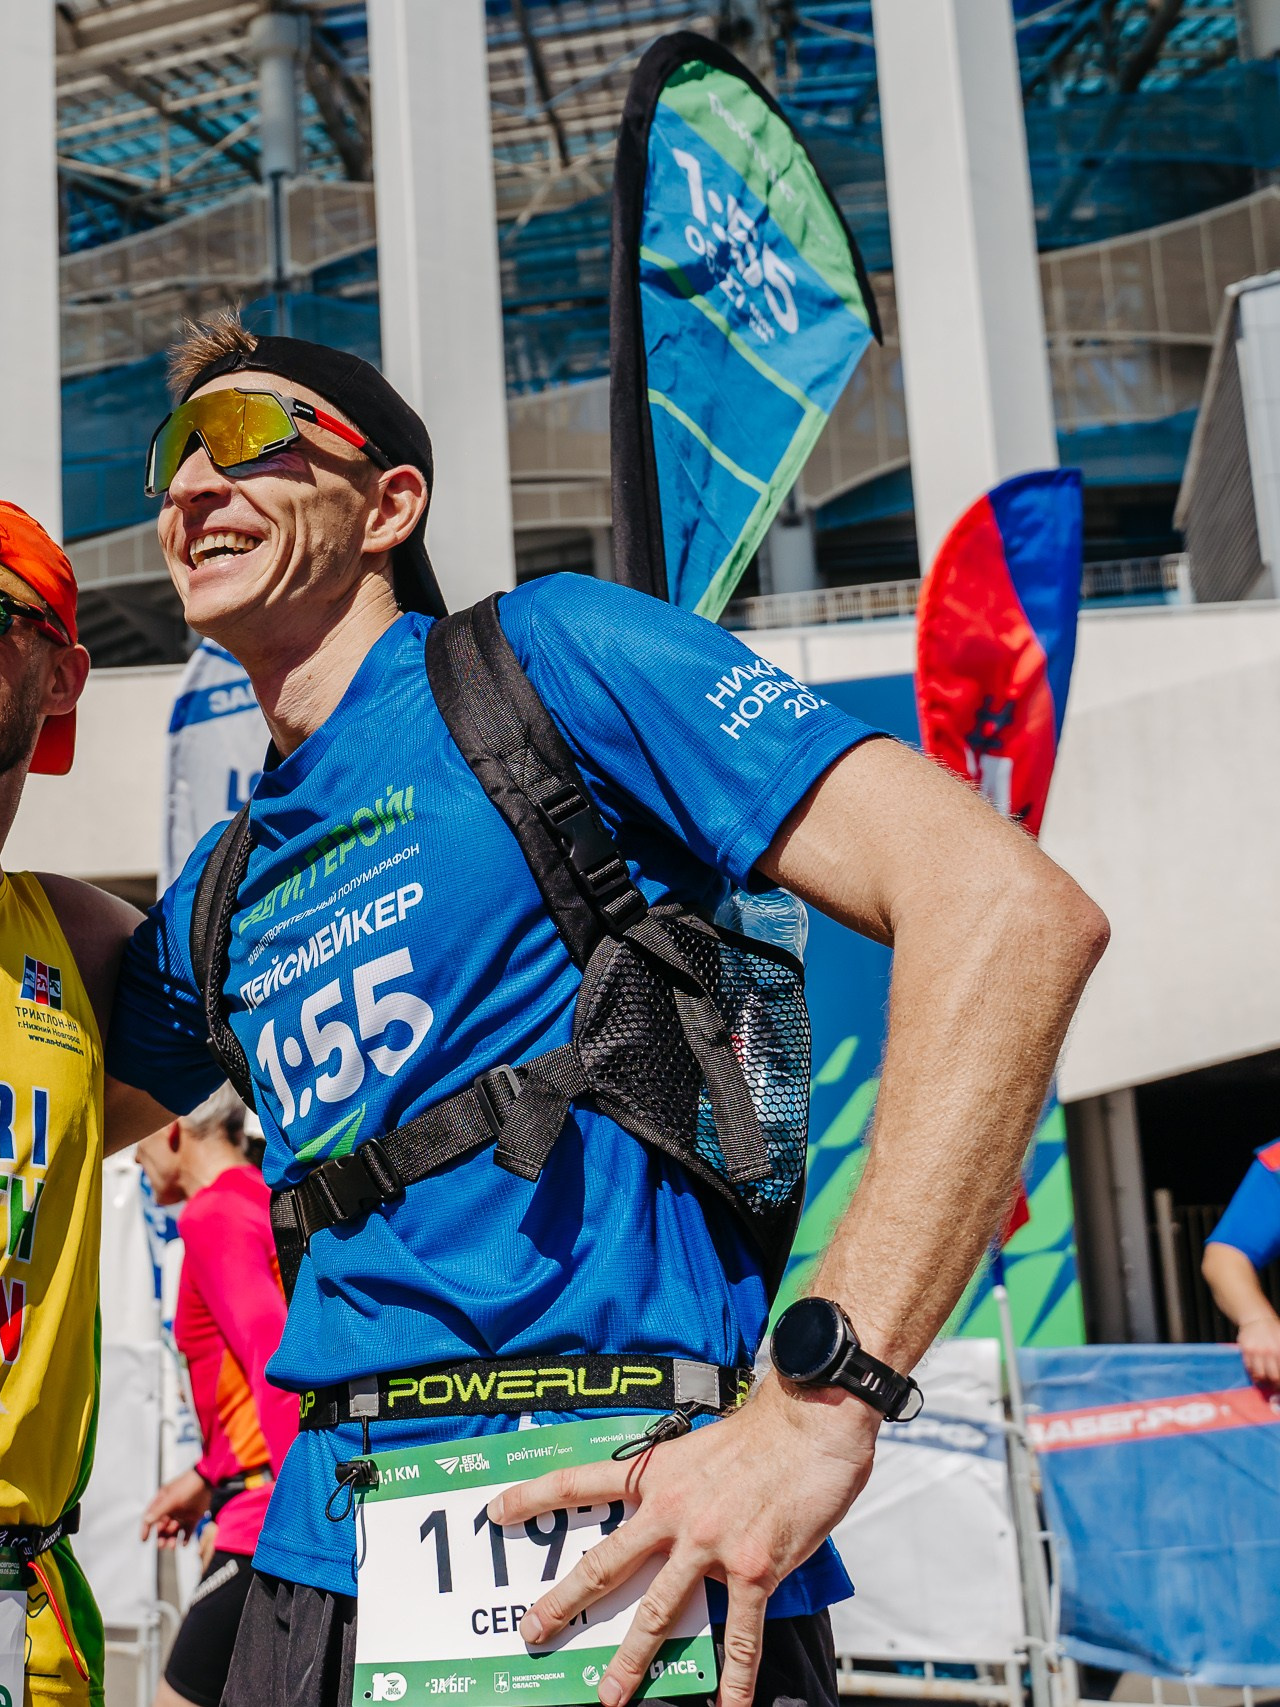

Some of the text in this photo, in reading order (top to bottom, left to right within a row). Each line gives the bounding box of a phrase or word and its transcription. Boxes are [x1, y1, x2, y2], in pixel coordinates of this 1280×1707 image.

[304, 785, 415, 889] ГЕРОЙ!
[337, 842, 421, 901] ПОЛУМАРАФОН
[239, 882, 424, 1015] ПЕЙСМЕЙКЕР
[15, 1006, 79, 1034] ТРИАТЛОН-НН
[256, 946, 434, 1129] 1:55
[388, 1365, 663, 1408] POWERUP
[376, 1467, 393, 1486] 1,1
[512, 1672, 565, 1682] НИЖЕГОРОДСКАЯ
[667, 1660, 698, 1676] ПСБ
